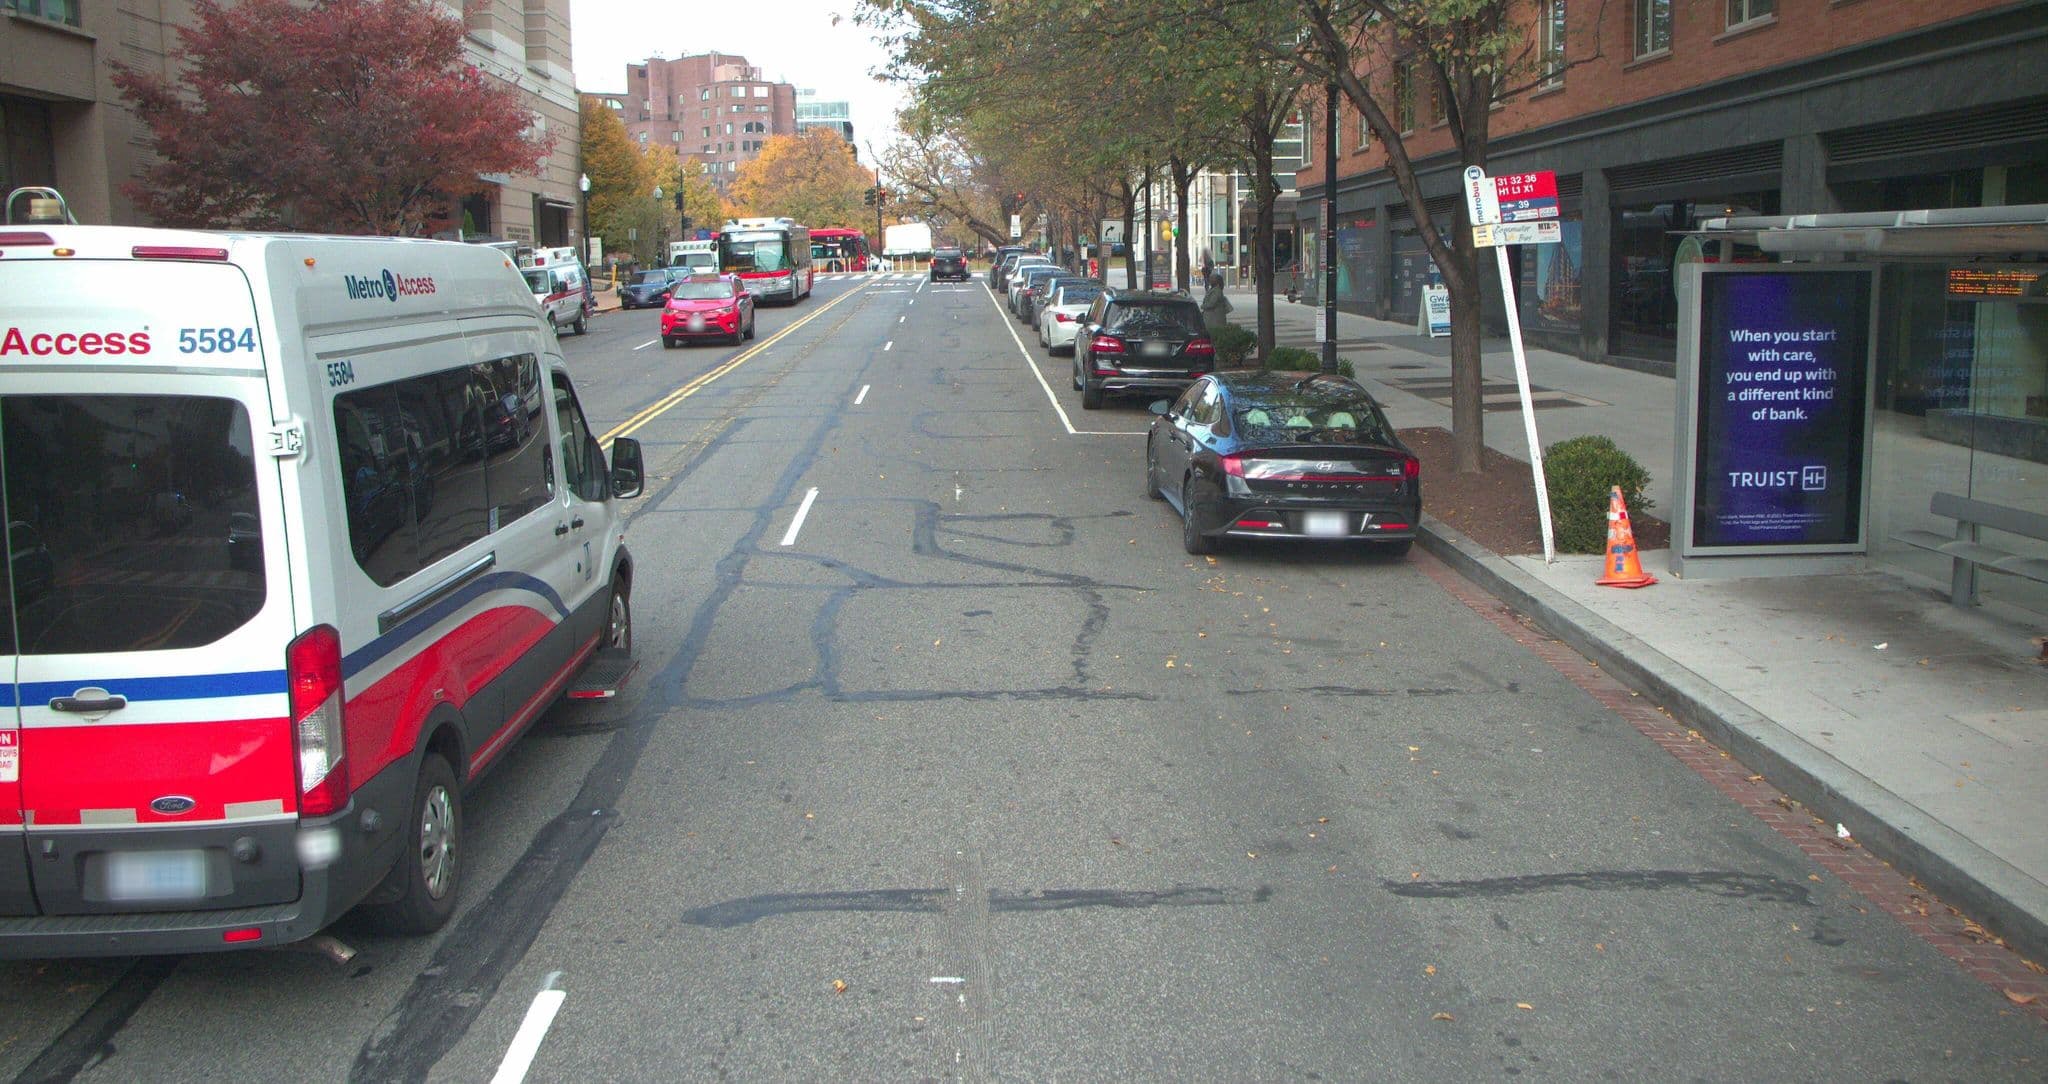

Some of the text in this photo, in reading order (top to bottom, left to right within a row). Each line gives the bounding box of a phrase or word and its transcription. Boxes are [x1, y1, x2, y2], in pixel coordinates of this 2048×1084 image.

[1497, 174, 1537, 186] 31 32 36
[1499, 188, 1509, 196] H1
[1472, 181, 1484, 223] metrobus
[1518, 200, 1530, 209] 39
[344, 273, 436, 300] Metro Access
[0, 327, 256, 355] Access 5584
[1730, 329, 1837, 344] When you start
[1748, 349, 1816, 363] with care,
[327, 360, 354, 387] 5584
[1726, 368, 1837, 384] you end up with
[1728, 388, 1834, 401] a different kind
[1752, 407, 1808, 420] of bank.
[1728, 471, 1798, 487] TRUIST
[159, 799, 185, 810] Ford
